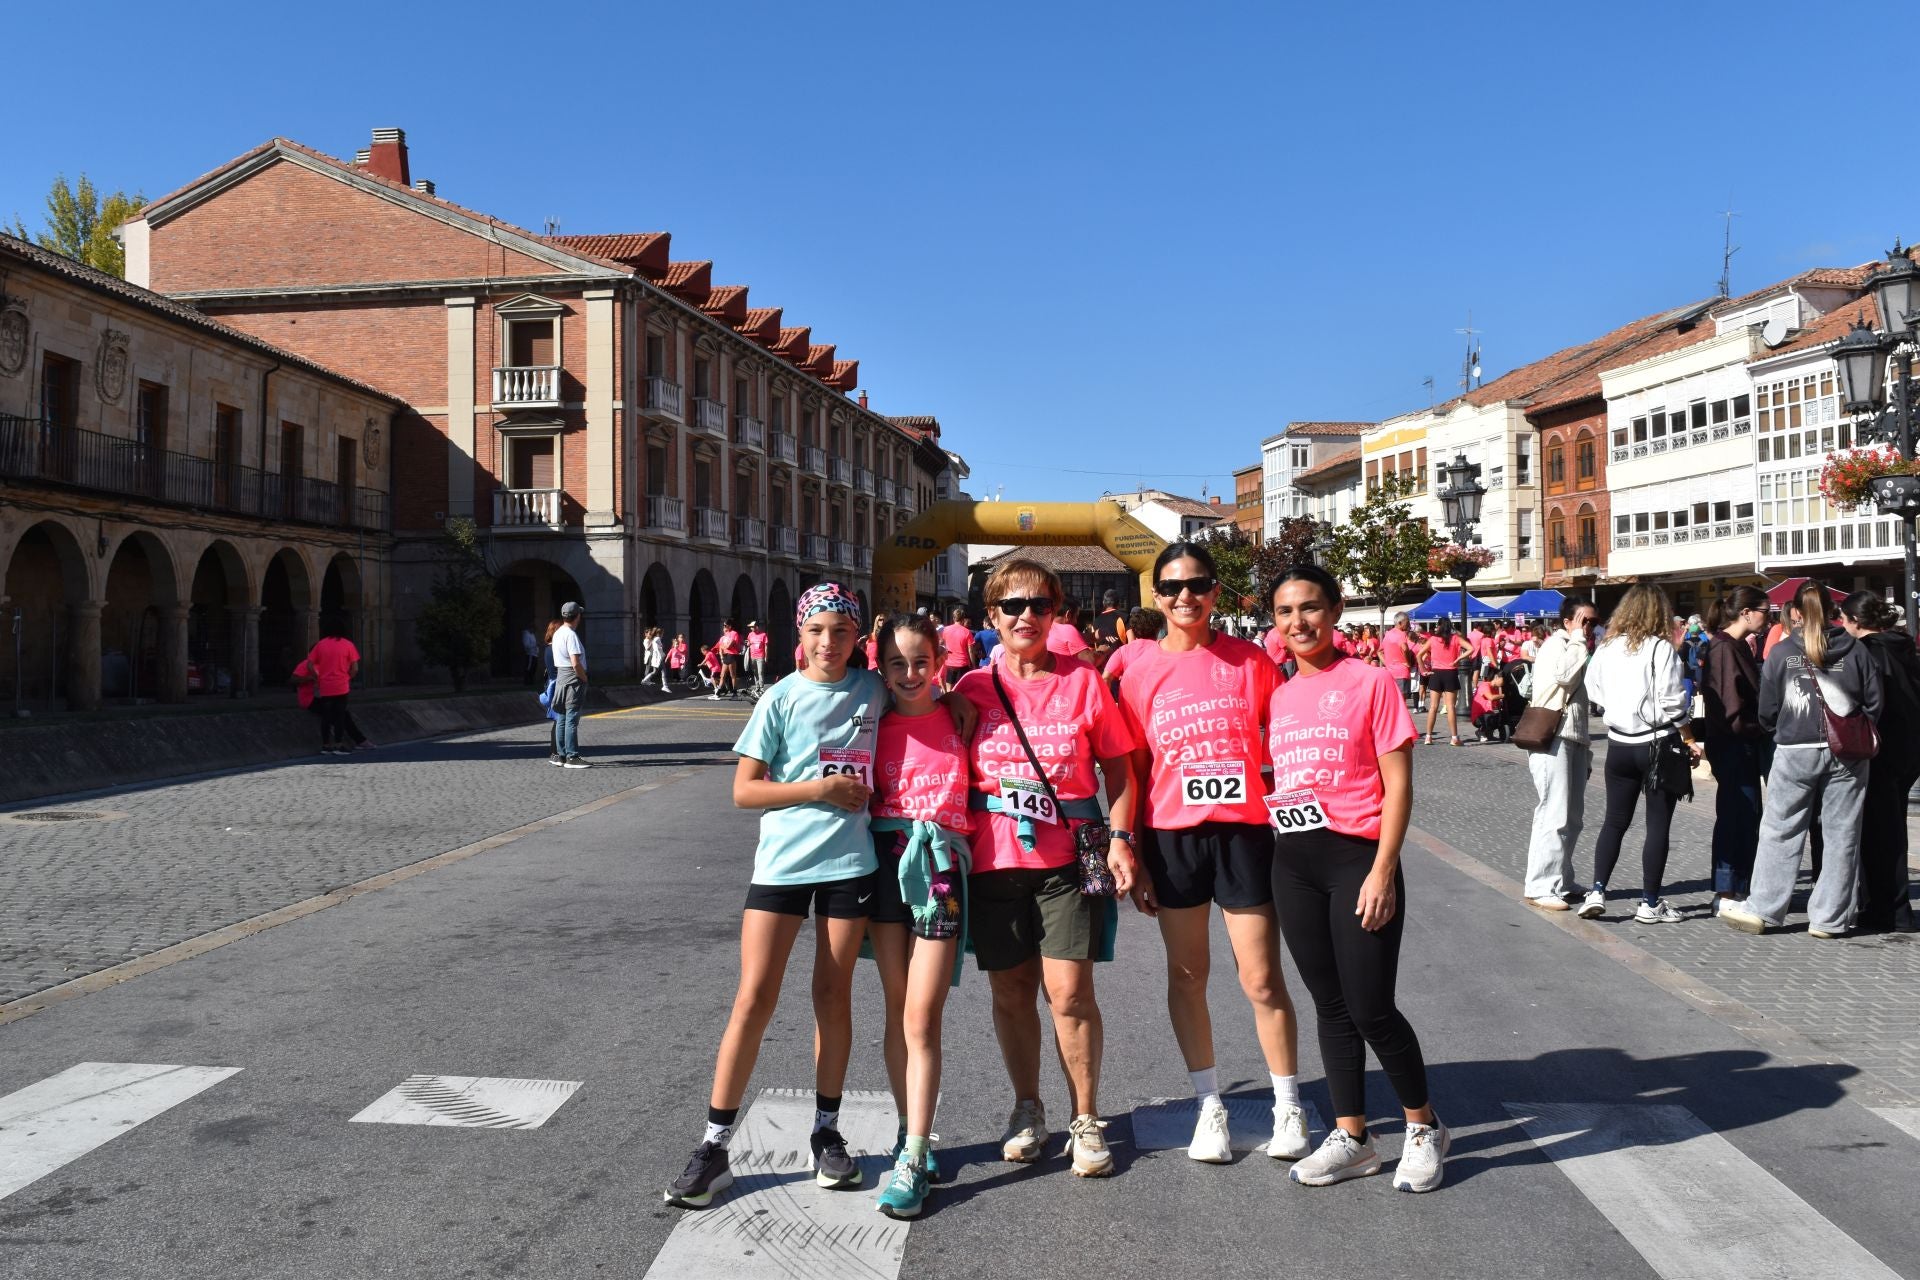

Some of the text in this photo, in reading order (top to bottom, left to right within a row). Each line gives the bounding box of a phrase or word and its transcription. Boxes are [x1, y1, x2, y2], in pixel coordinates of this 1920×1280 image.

[1156, 709, 1176, 726] En
[1181, 695, 1248, 716] marcha
[987, 722, 1009, 735] En
[1160, 716, 1229, 744] contra
[1231, 713, 1248, 731] el
[1270, 722, 1349, 748] En marcha
[982, 739, 1079, 758] conra el
[1165, 737, 1250, 765] cáncer
[1273, 743, 1345, 770] contra el
[823, 764, 868, 786] 601
[1275, 767, 1346, 793] cáncer
[954, 790, 967, 808] el
[1187, 778, 1242, 800] 602
[1007, 791, 1053, 818] 149
[1276, 804, 1323, 829] 603
